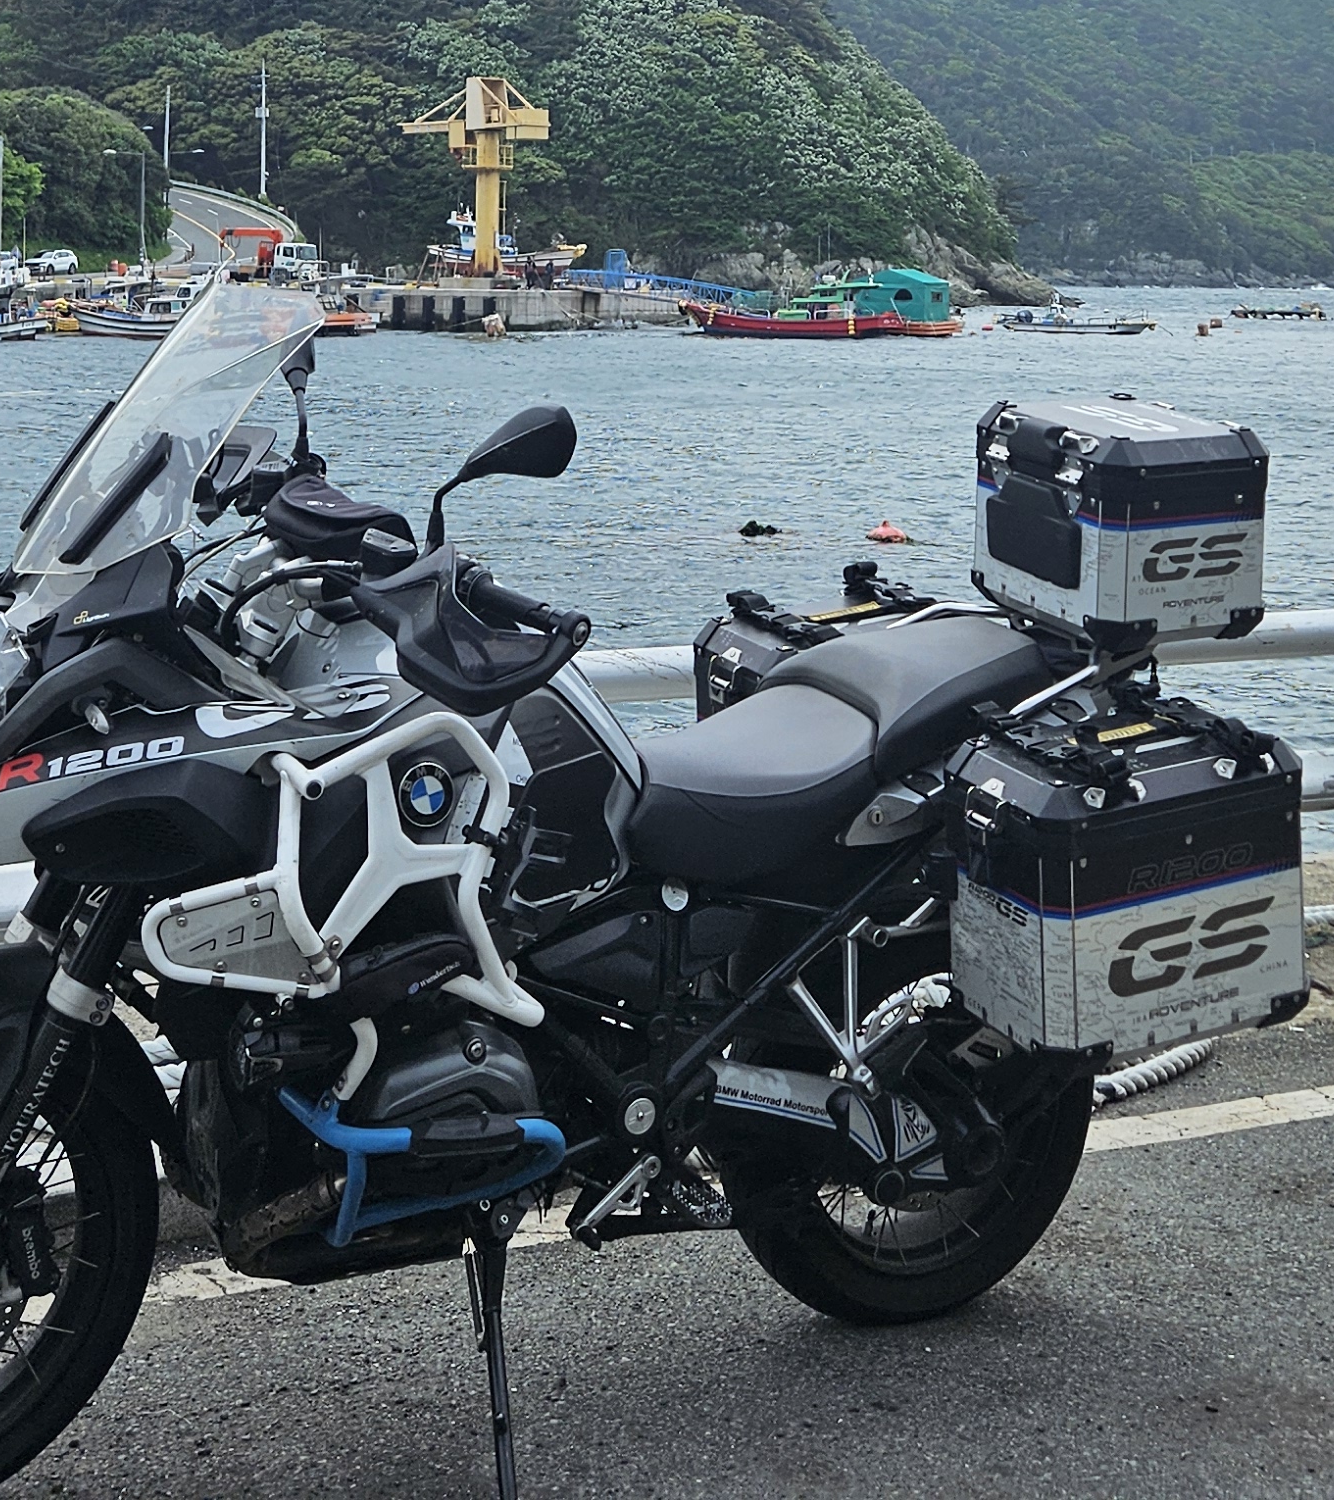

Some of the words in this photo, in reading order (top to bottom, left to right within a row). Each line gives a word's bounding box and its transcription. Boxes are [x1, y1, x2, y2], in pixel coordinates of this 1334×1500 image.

[1142, 532, 1249, 583] GS
[1138, 586, 1167, 597] OCEAN
[1162, 594, 1226, 609] ADVENTURE
[401, 766, 446, 793] BMW
[1126, 841, 1253, 895] R1200
[996, 897, 1029, 928] GS
[1108, 895, 1275, 998] GS
[1259, 959, 1289, 975] CHINA
[1148, 986, 1240, 1020] ADVENTURE
[1, 1038, 71, 1153] TOURATECH
[715, 1084, 739, 1097] BMW
[740, 1089, 782, 1107] Motorrad
[783, 1098, 828, 1117] Motorspor
[21, 1225, 42, 1280] brembo
